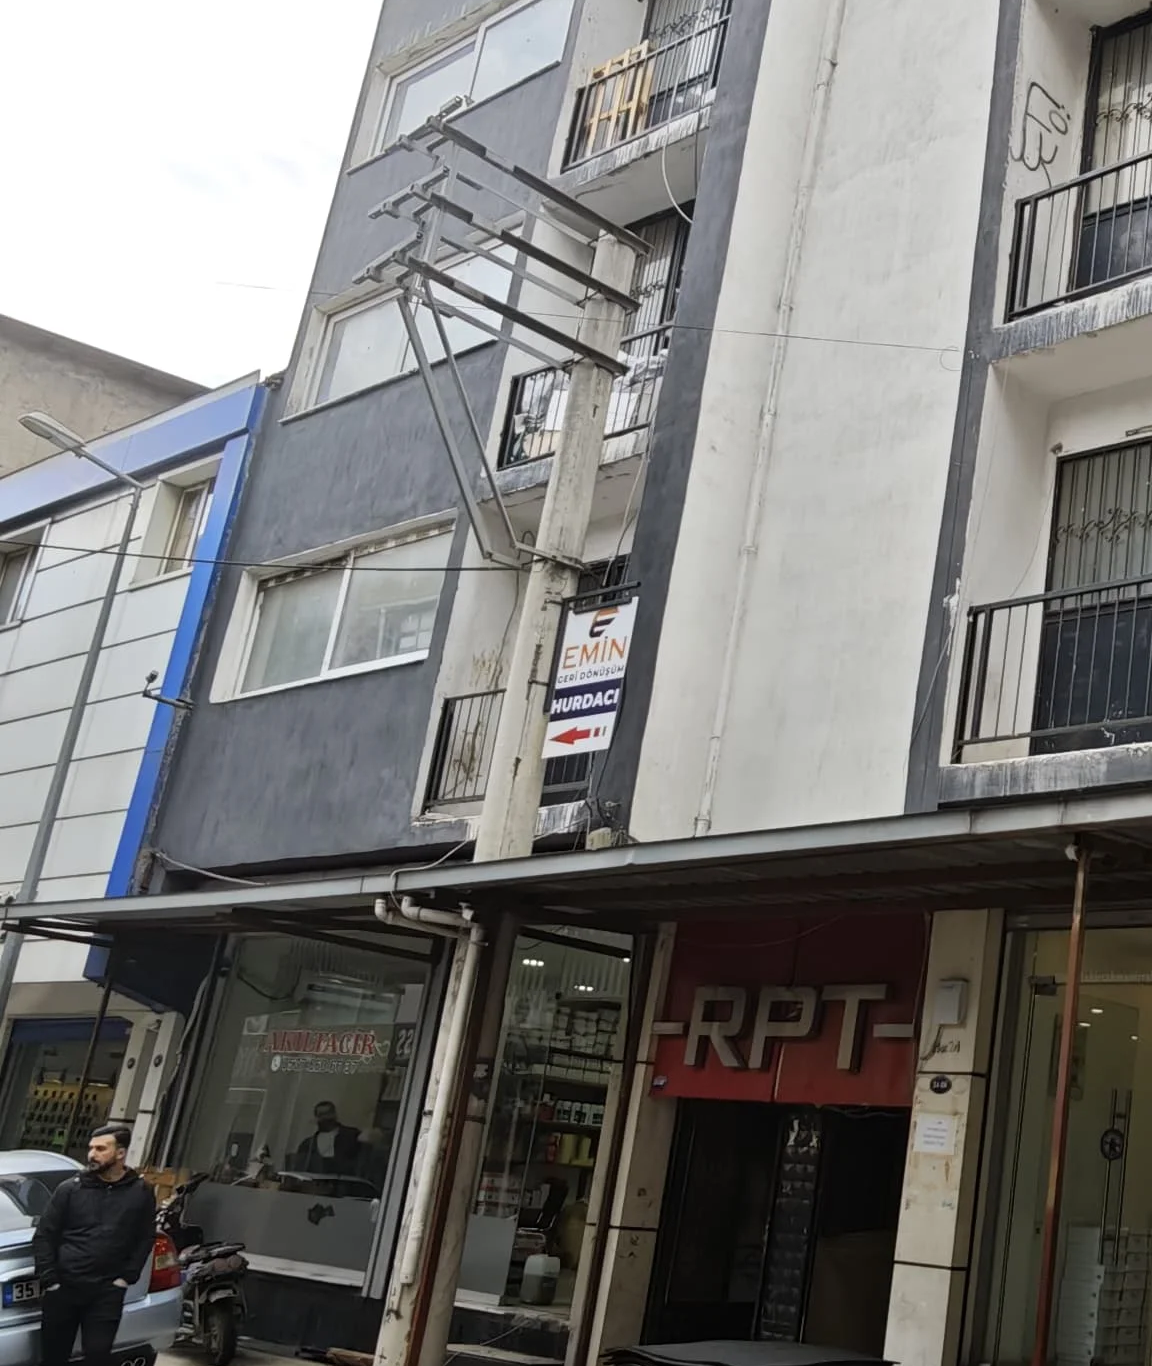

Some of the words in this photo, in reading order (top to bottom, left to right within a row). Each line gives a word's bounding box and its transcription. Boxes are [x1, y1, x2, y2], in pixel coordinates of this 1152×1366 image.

[562, 636, 627, 669] EMİN
[558, 669, 578, 684] GERİ
[580, 665, 624, 681] DÖNÜŞÜM
[551, 688, 620, 714] HURDACI
